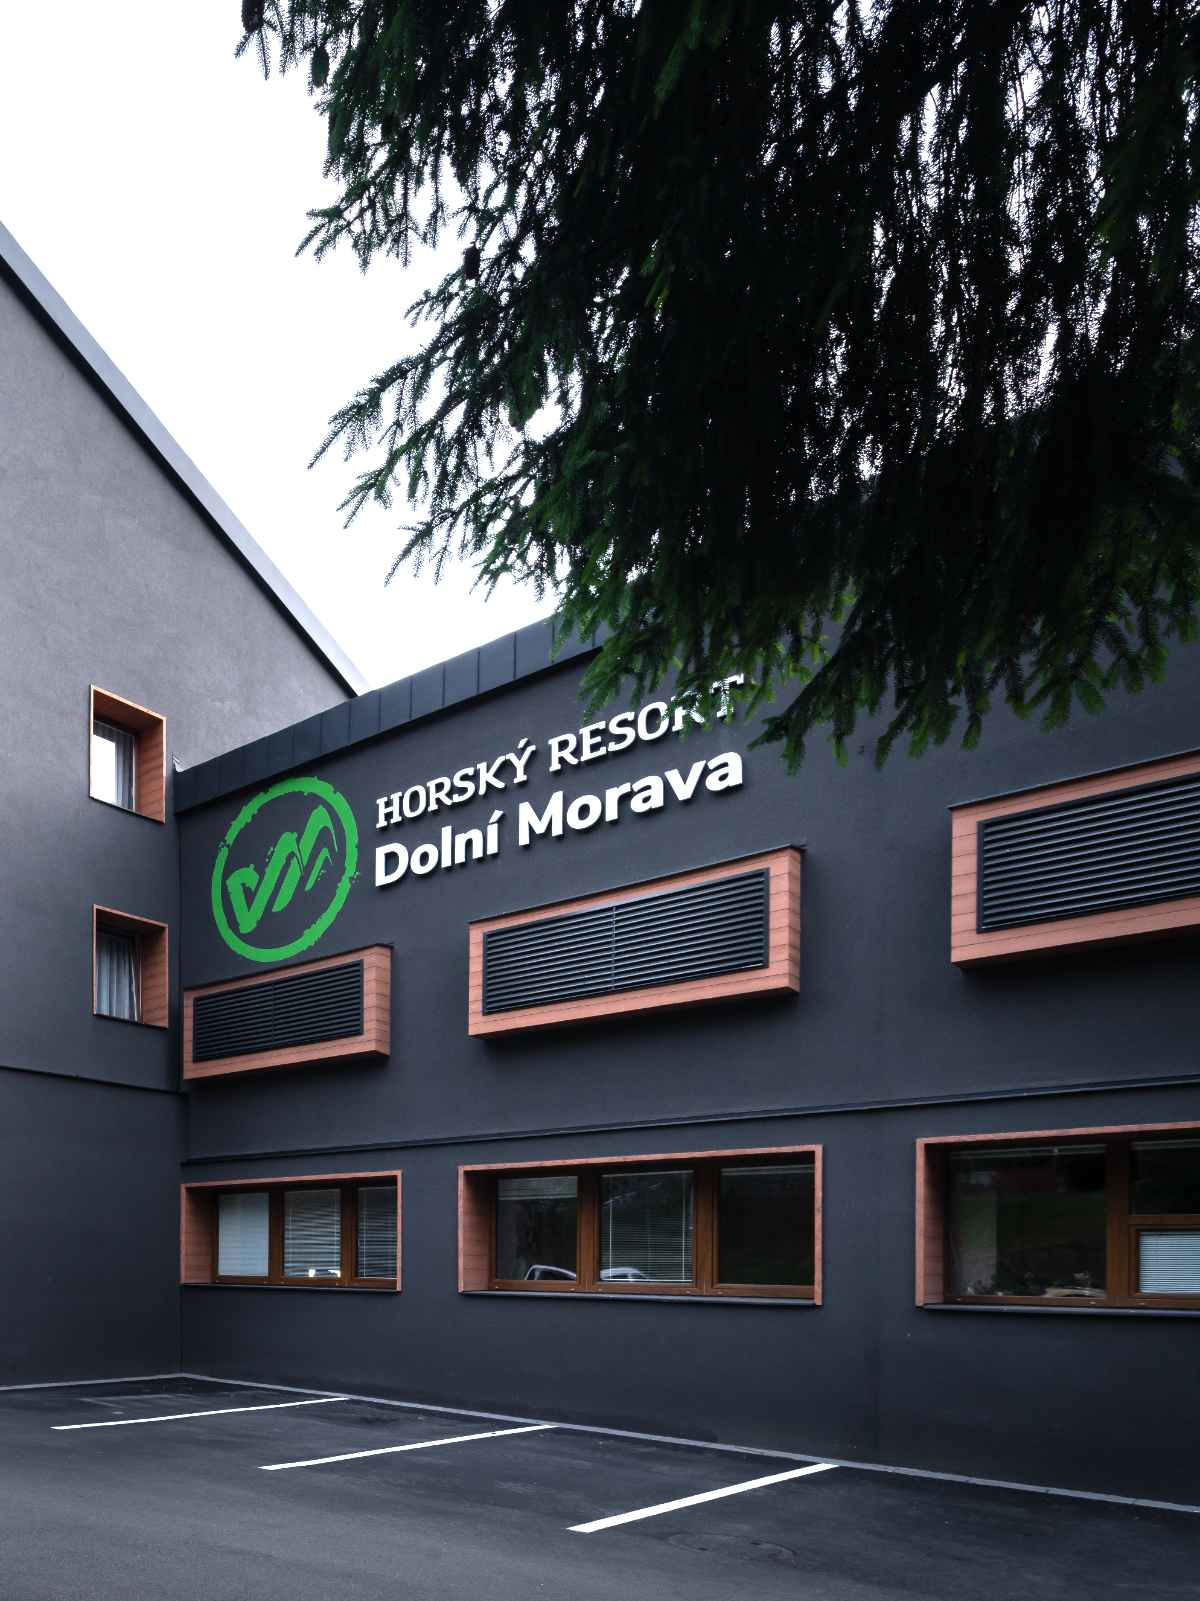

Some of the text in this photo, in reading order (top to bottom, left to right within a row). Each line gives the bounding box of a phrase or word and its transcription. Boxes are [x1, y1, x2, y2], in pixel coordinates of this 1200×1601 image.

[375, 751, 743, 887] Dolní Morava
[376, 737, 535, 827] HORSKÝ
